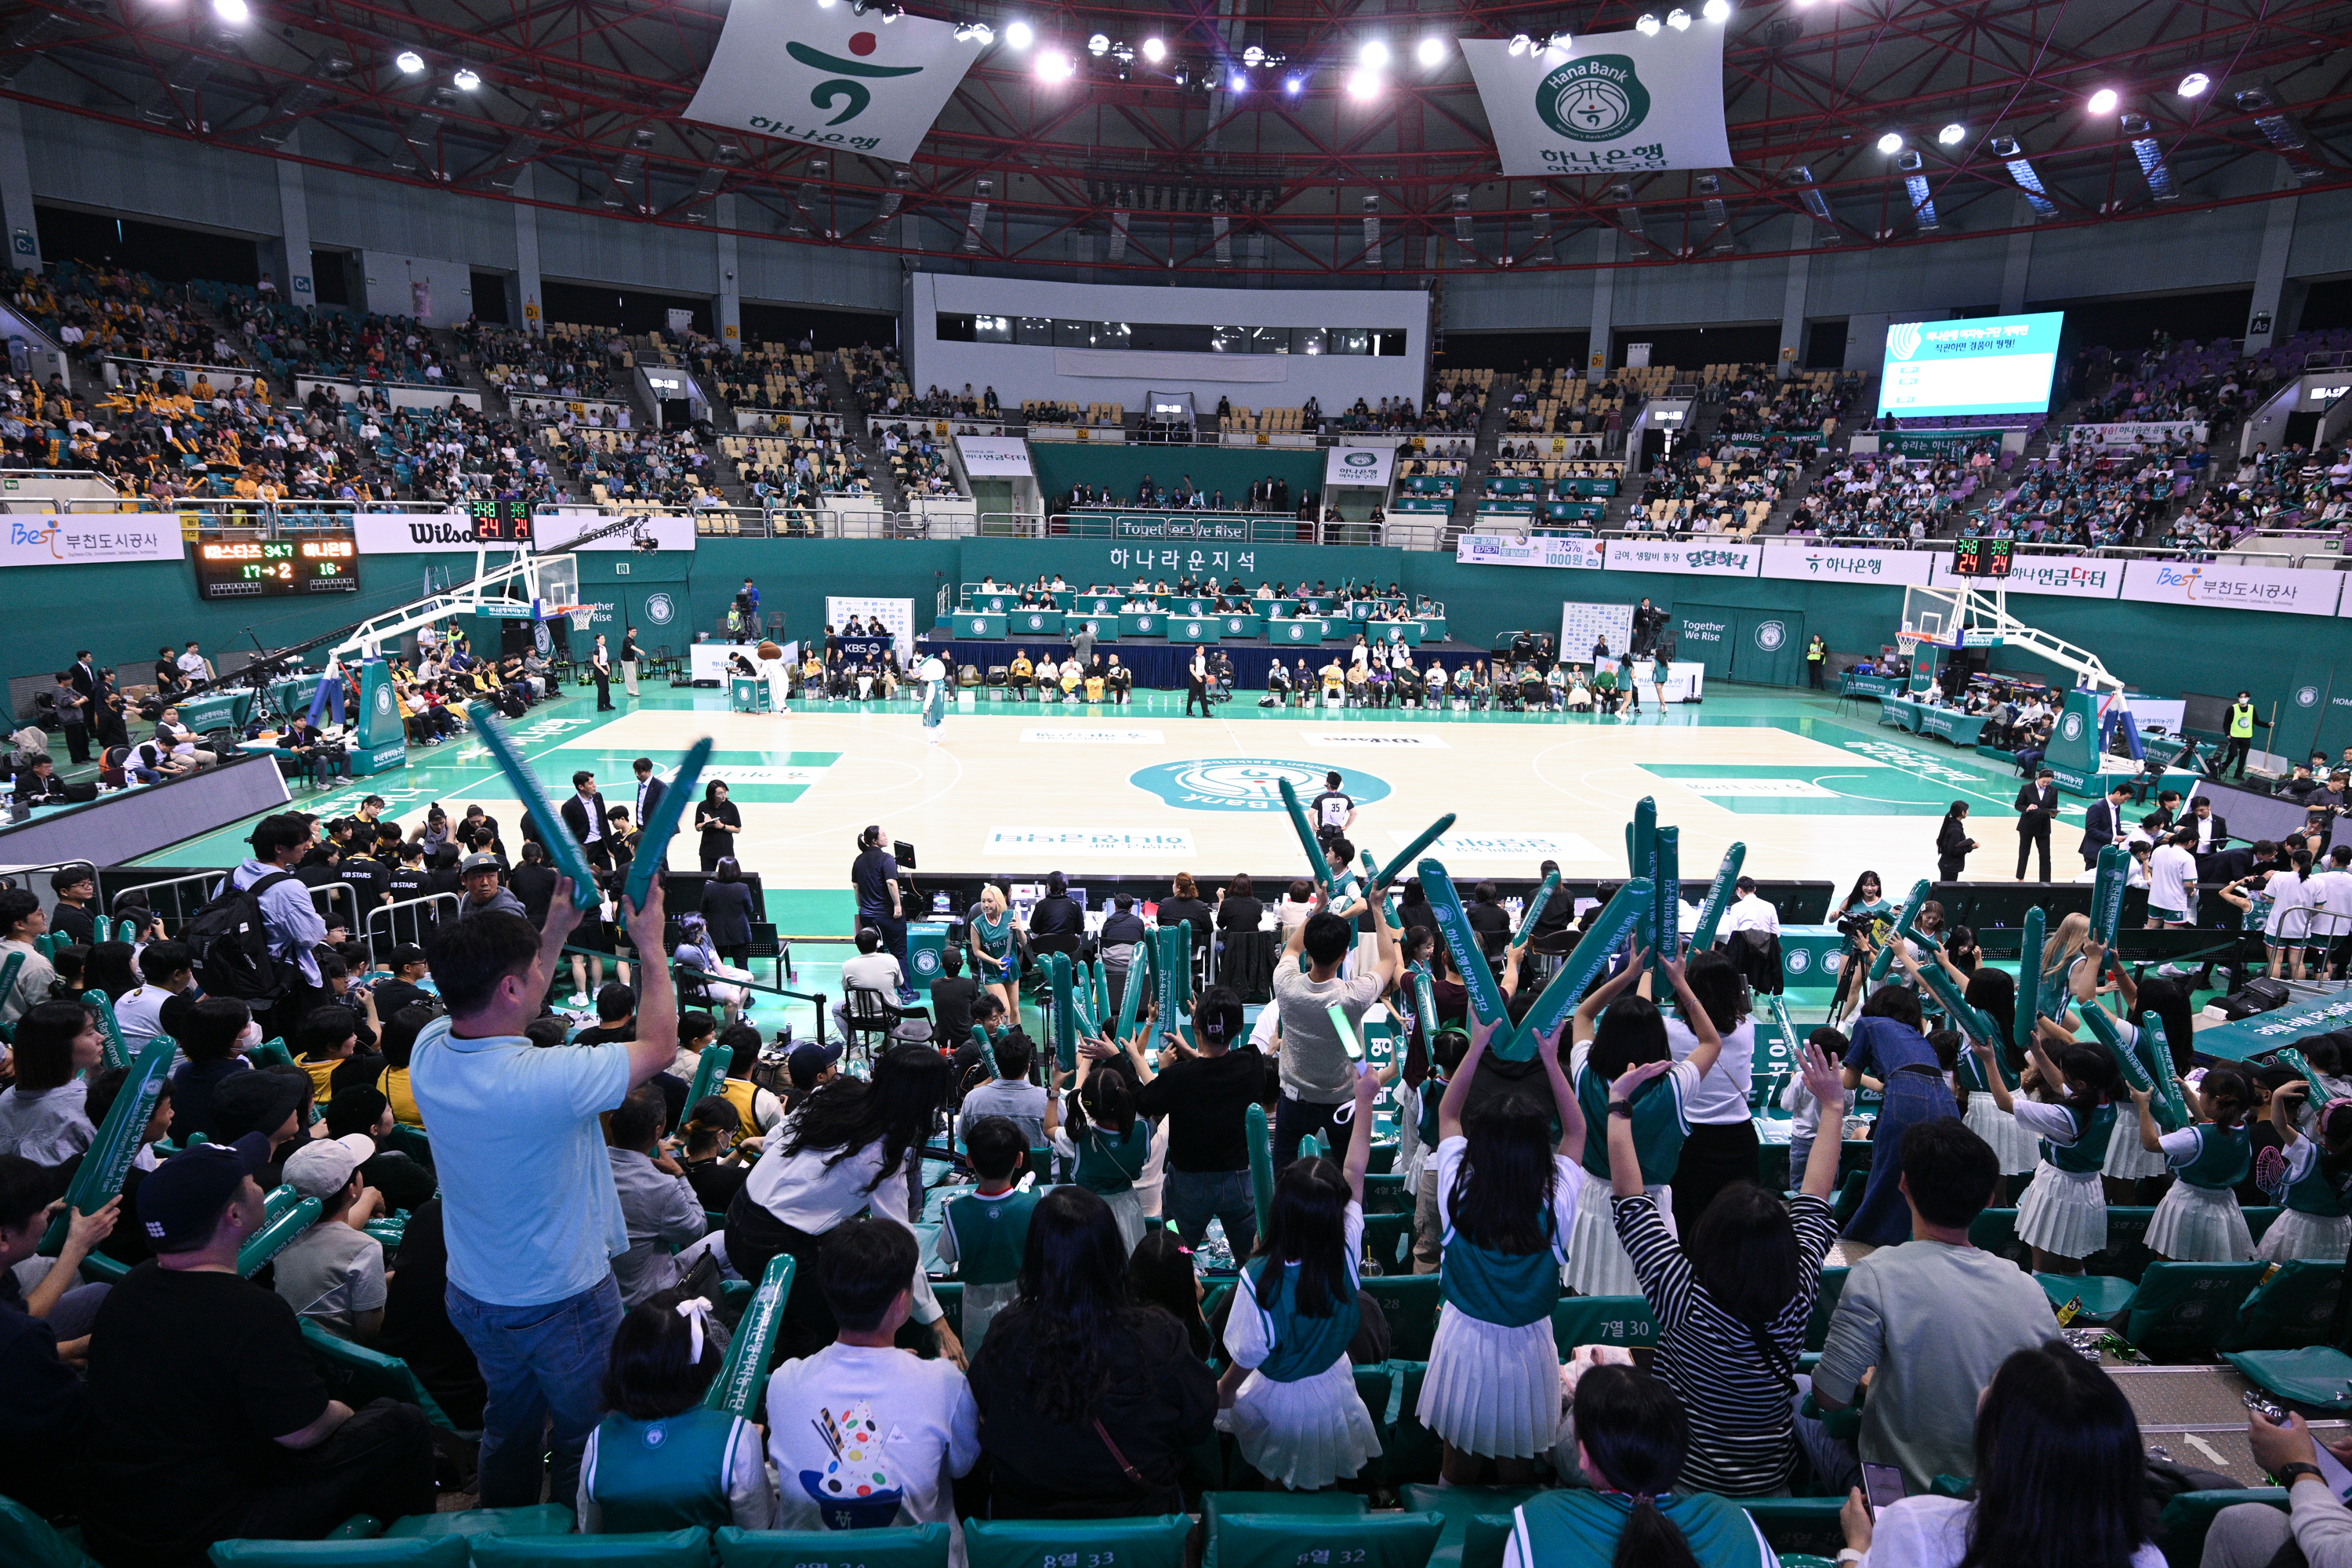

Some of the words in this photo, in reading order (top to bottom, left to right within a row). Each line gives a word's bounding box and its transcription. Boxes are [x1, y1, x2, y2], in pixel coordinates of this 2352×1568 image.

[1547, 63, 1587, 90] Hana
[1589, 60, 1630, 84] Bank
[749, 114, 881, 151] 하나은행
[1555, 122, 1584, 140] Women's
[1584, 129, 1621, 140] Basketball
[1619, 118, 1637, 132] Team
[1540, 143, 1664, 165] 하나은행
[16, 238, 33, 252] C7
[296, 278, 309, 291] C8
[526, 307, 538, 318] D1
[726, 328, 736, 337] D2
[2253, 321, 2268, 332] A2
[1935, 343, 1966, 353] 직관하면
[1969, 340, 1993, 351] 경품이
[1592, 357, 1602, 366] D7
[1731, 434, 1766, 442] 하나카드가
[1900, 441, 1928, 451] 승리는
[473, 503, 495, 517] 34:8
[408, 523, 474, 543] Wilso
[480, 517, 499, 536] 24
[515, 518, 528, 537] 24
[1215, 525, 1242, 537] Rise
[11, 521, 64, 559] Best
[67, 534, 158, 550] 부천도시공사
[1559, 540, 1581, 553] 75%
[1958, 539, 1978, 554] 34:8
[204, 544, 262, 559] KB스타즈
[303, 543, 352, 557] 하나은행
[1614, 550, 1632, 561] 급여,
[1635, 551, 1660, 562] 생활비
[1663, 553, 1679, 563] 통장
[1110, 548, 1254, 572] 하나라운지석
[1545, 553, 1582, 566] 1000원
[1686, 550, 1748, 570] 달달하나
[1827, 557, 1882, 575] 하나은행
[1959, 554, 1978, 572] 24
[1991, 556, 2008, 574] 24
[243, 565, 260, 579] 17
[278, 563, 292, 579] 2
[320, 563, 336, 575] 16
[2012, 566, 2035, 581] 하나
[2038, 567, 2106, 589] 연금닥터
[2157, 568, 2201, 600] Best
[2203, 580, 2297, 600] 부천도시공사
[593, 613, 612, 622] Rise
[1683, 619, 1725, 632] Together
[1685, 630, 1700, 640] We
[1701, 632, 1720, 641] Rise
[844, 644, 866, 653] KBS
[2332, 697, 2352, 706] HOM
[1178, 793, 1269, 808] Bank
[1331, 804, 1341, 814] 35
[994, 833, 1182, 844] 하나연금닥터
[1664, 879, 1676, 912] 여자농구단
[1617, 911, 1642, 935] Hana
[1663, 912, 1677, 951] 하나은행
[1602, 933, 1624, 953] Bank
[1446, 927, 1470, 967] 하나은행
[1465, 967, 1490, 1012] 여자농구단
[98, 1022, 113, 1039] Bank
[2253, 1024, 2298, 1036] Rise
[2285, 1017, 2317, 1027] We
[105, 1039, 125, 1069] Women'
[118, 1126, 133, 1151] Women's
[107, 1150, 122, 1178] Basketball
[101, 1177, 113, 1192] Team
[263, 1206, 287, 1228] Hana
[288, 1222, 310, 1243] Hana
[2132, 1221, 2145, 1230] 23
[266, 1239, 289, 1261] Bank
[2191, 1279, 2212, 1290] 5열
[2214, 1279, 2230, 1289] 24
[943, 1302, 957, 1316] 31
[1384, 1298, 1399, 1308] 28
[1600, 1320, 1624, 1338] 7열
[1630, 1320, 1649, 1336] 30
[1044, 1552, 1078, 1568] 8열
[1088, 1552, 1113, 1568] 33
[1297, 1549, 1330, 1566] 8열
[1340, 1548, 1366, 1564] 32
